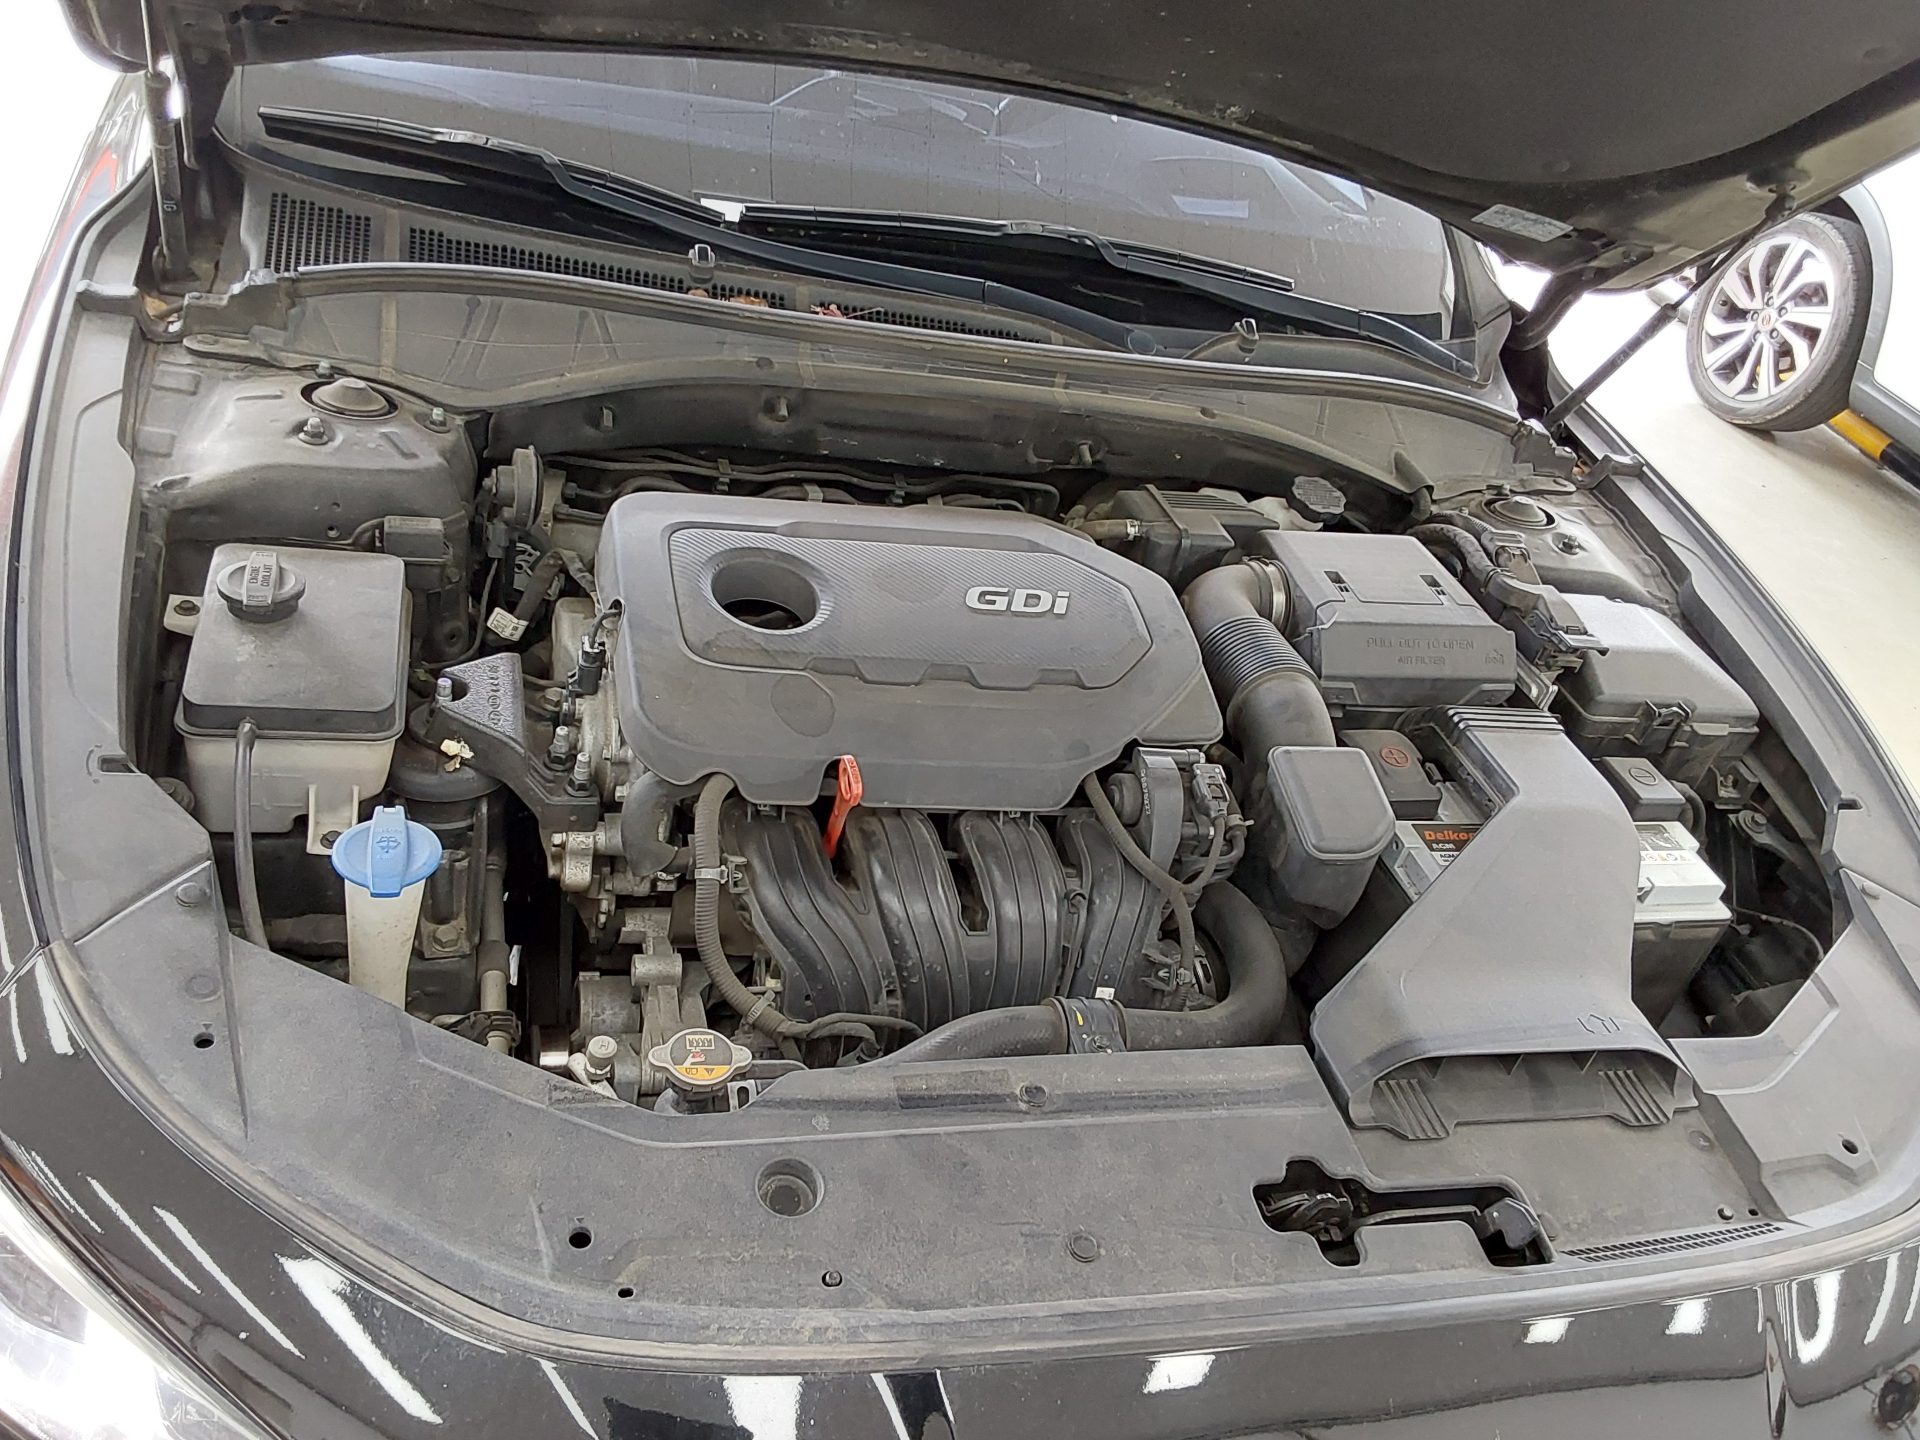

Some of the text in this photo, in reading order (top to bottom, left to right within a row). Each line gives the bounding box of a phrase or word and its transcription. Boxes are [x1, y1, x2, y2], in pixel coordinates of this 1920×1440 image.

[248, 565, 261, 584] ENGINE
[260, 563, 273, 587] COOLANT
[964, 586, 1071, 616] GDi
[1366, 637, 1475, 650] PULL OUT TO OPEN
[1397, 655, 1446, 666] AIR FILTER
